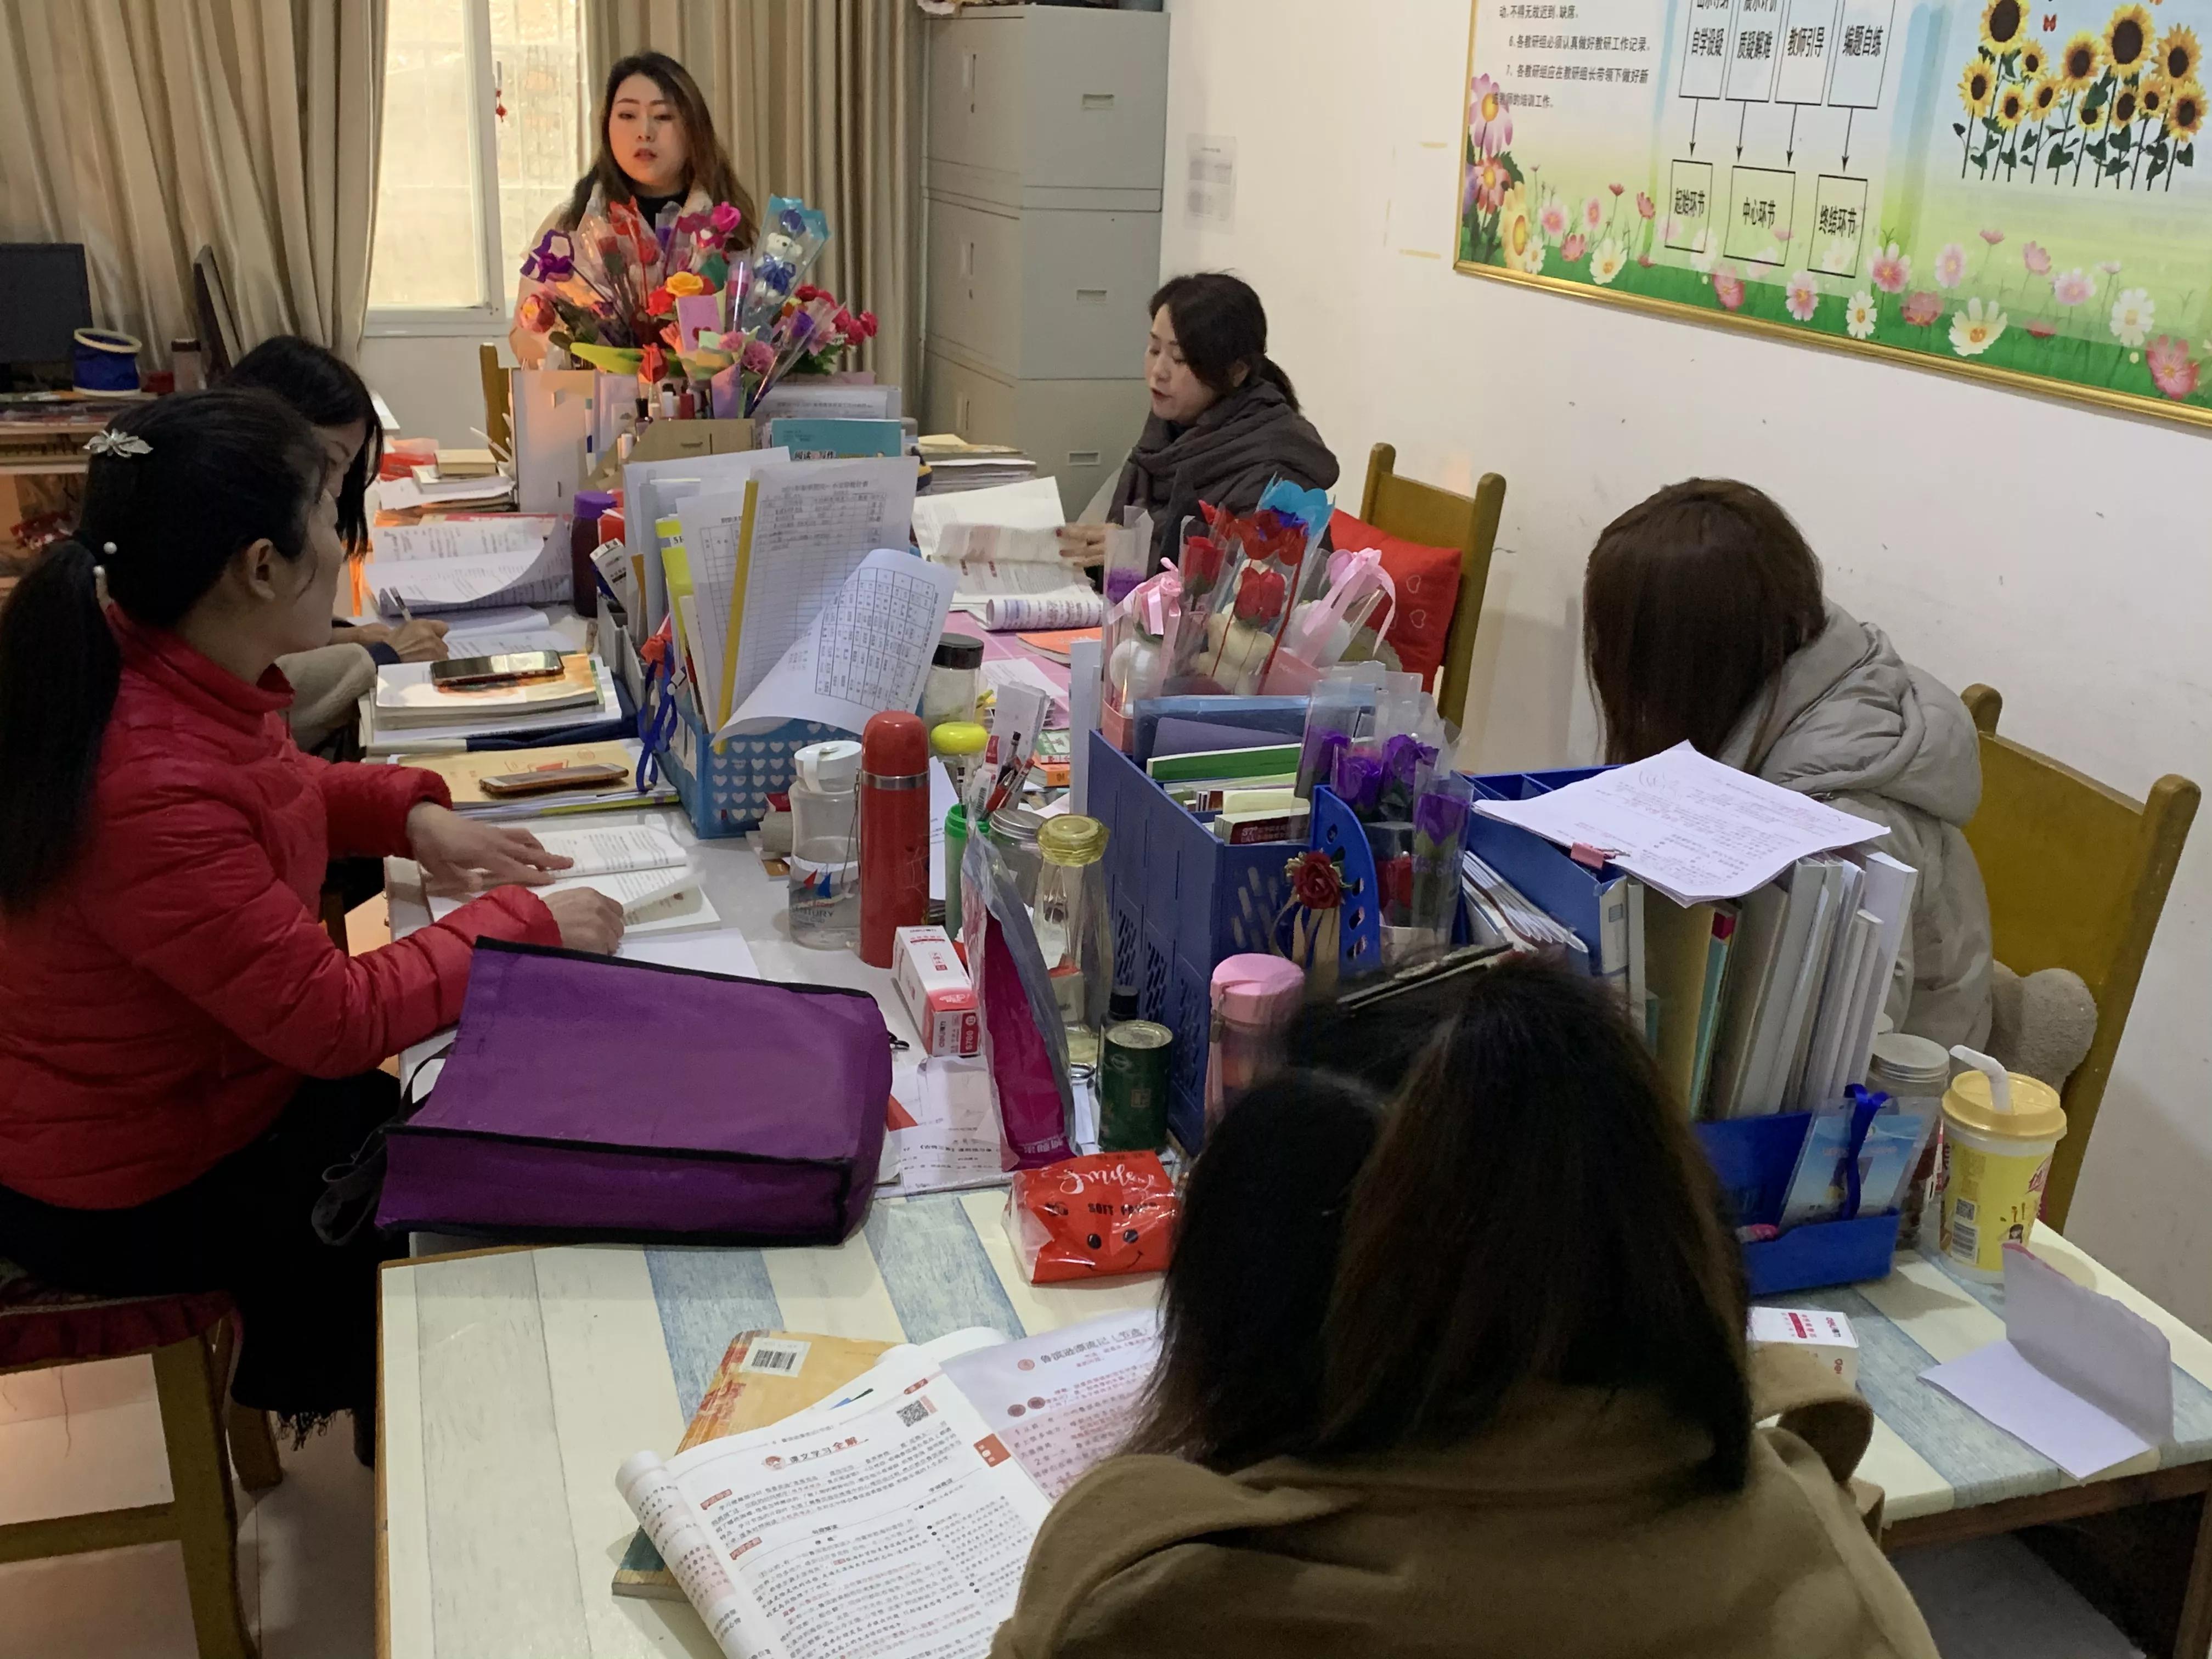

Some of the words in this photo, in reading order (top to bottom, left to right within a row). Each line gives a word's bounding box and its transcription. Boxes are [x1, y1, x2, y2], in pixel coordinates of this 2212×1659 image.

[1692, 27, 1724, 56] 自学设疑
[1787, 26, 1825, 57] 教师引导
[1674, 188, 1705, 218] 起始环节
[1742, 196, 1776, 229] 中心环节
[1818, 205, 1857, 238] 终结环节
